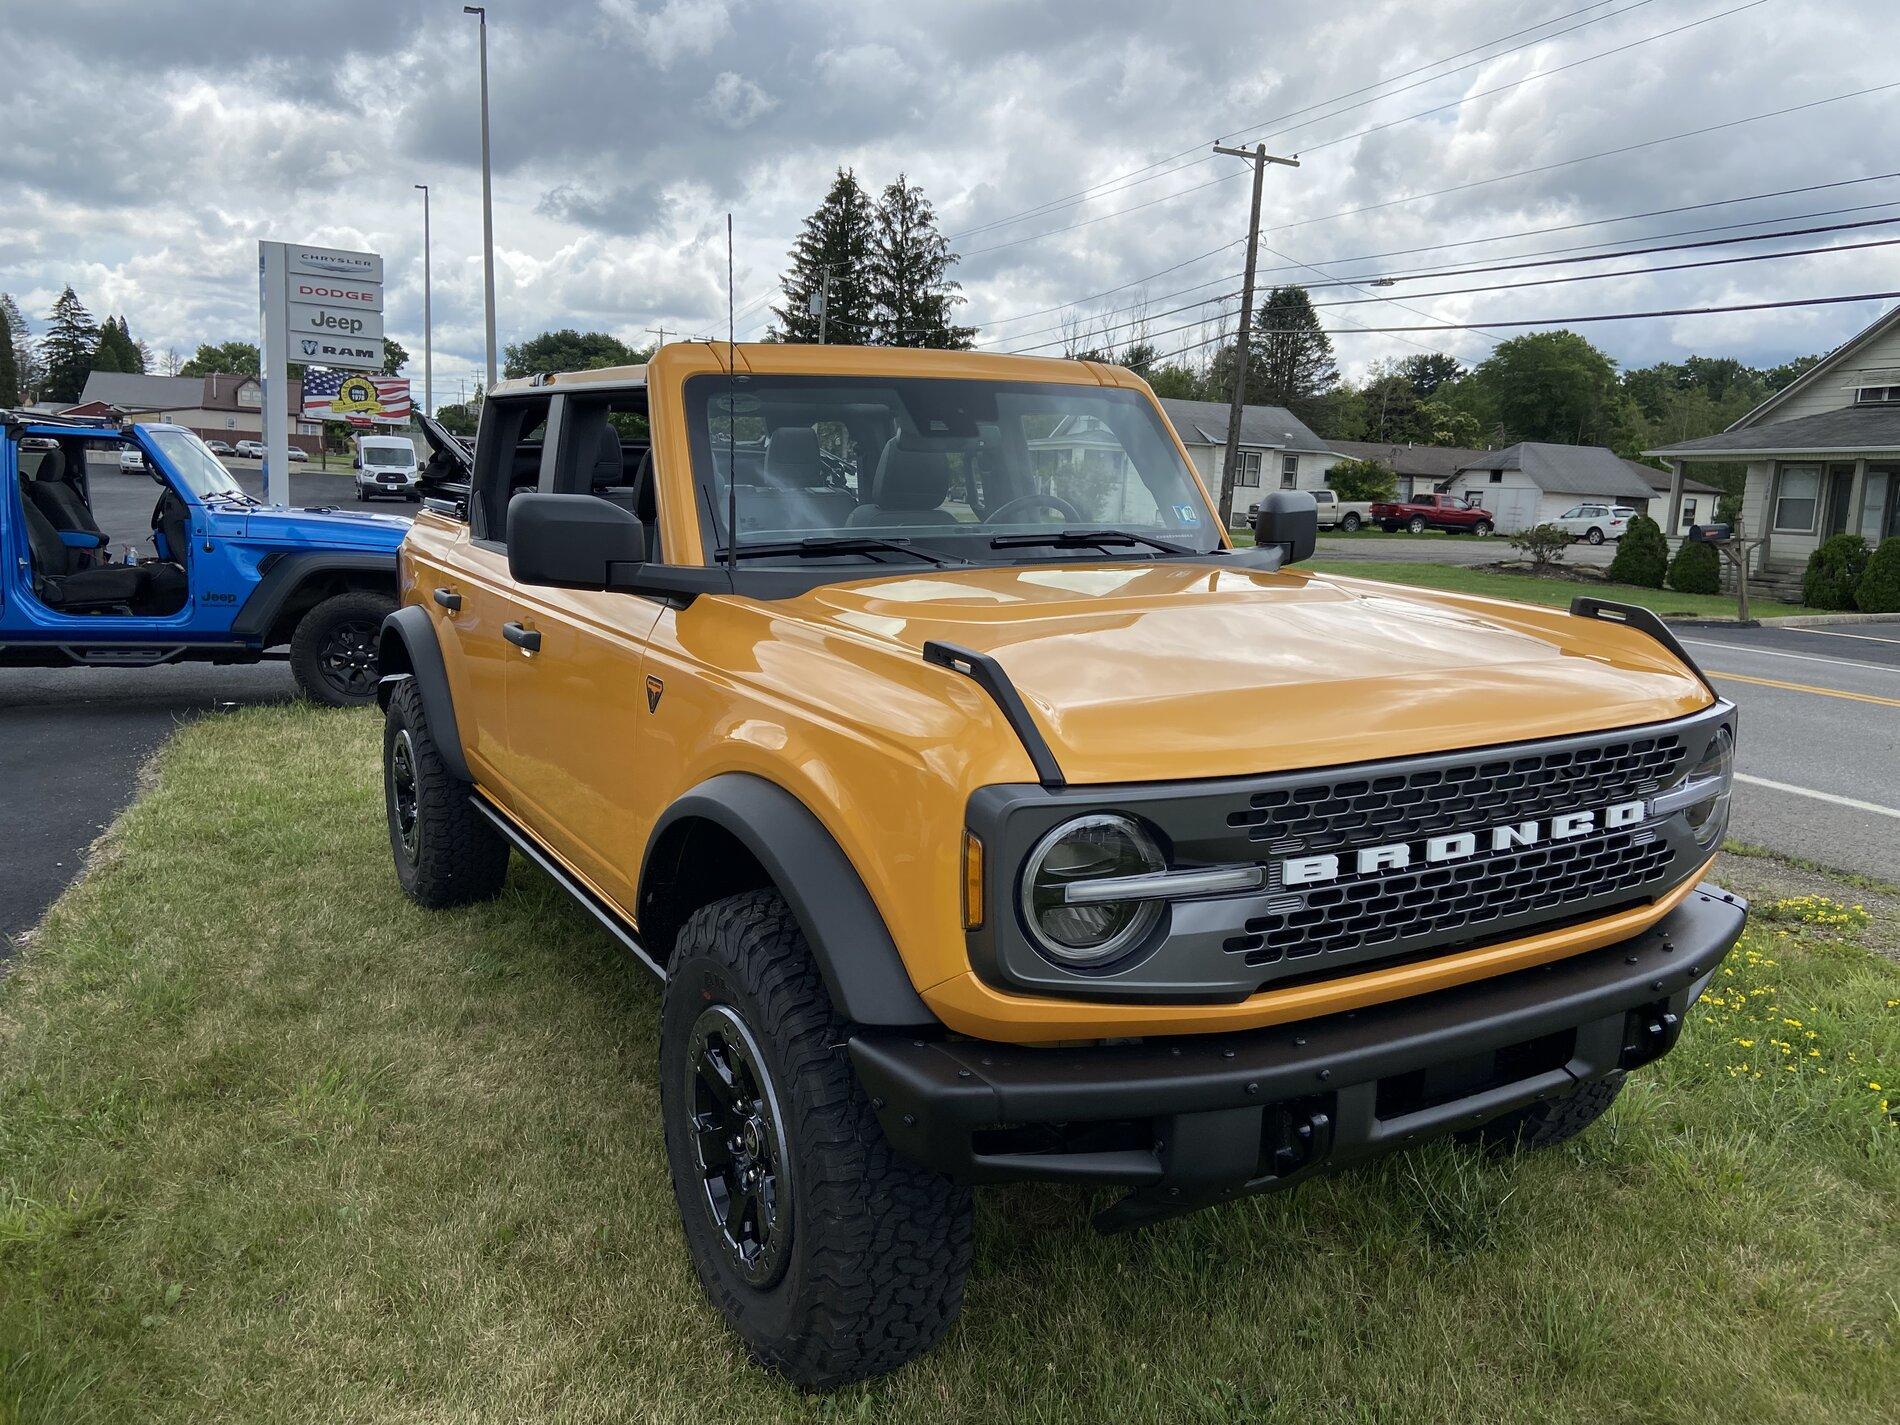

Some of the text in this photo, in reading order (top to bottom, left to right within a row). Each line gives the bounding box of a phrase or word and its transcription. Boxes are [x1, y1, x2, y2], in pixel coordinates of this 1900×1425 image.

[301, 253, 372, 267] CHRYSLER
[299, 285, 374, 302] DODGE
[311, 311, 363, 333] Jeep
[322, 345, 374, 359] RAM
[201, 591, 237, 604] Jeep
[1281, 800, 1645, 886] BRONCO
